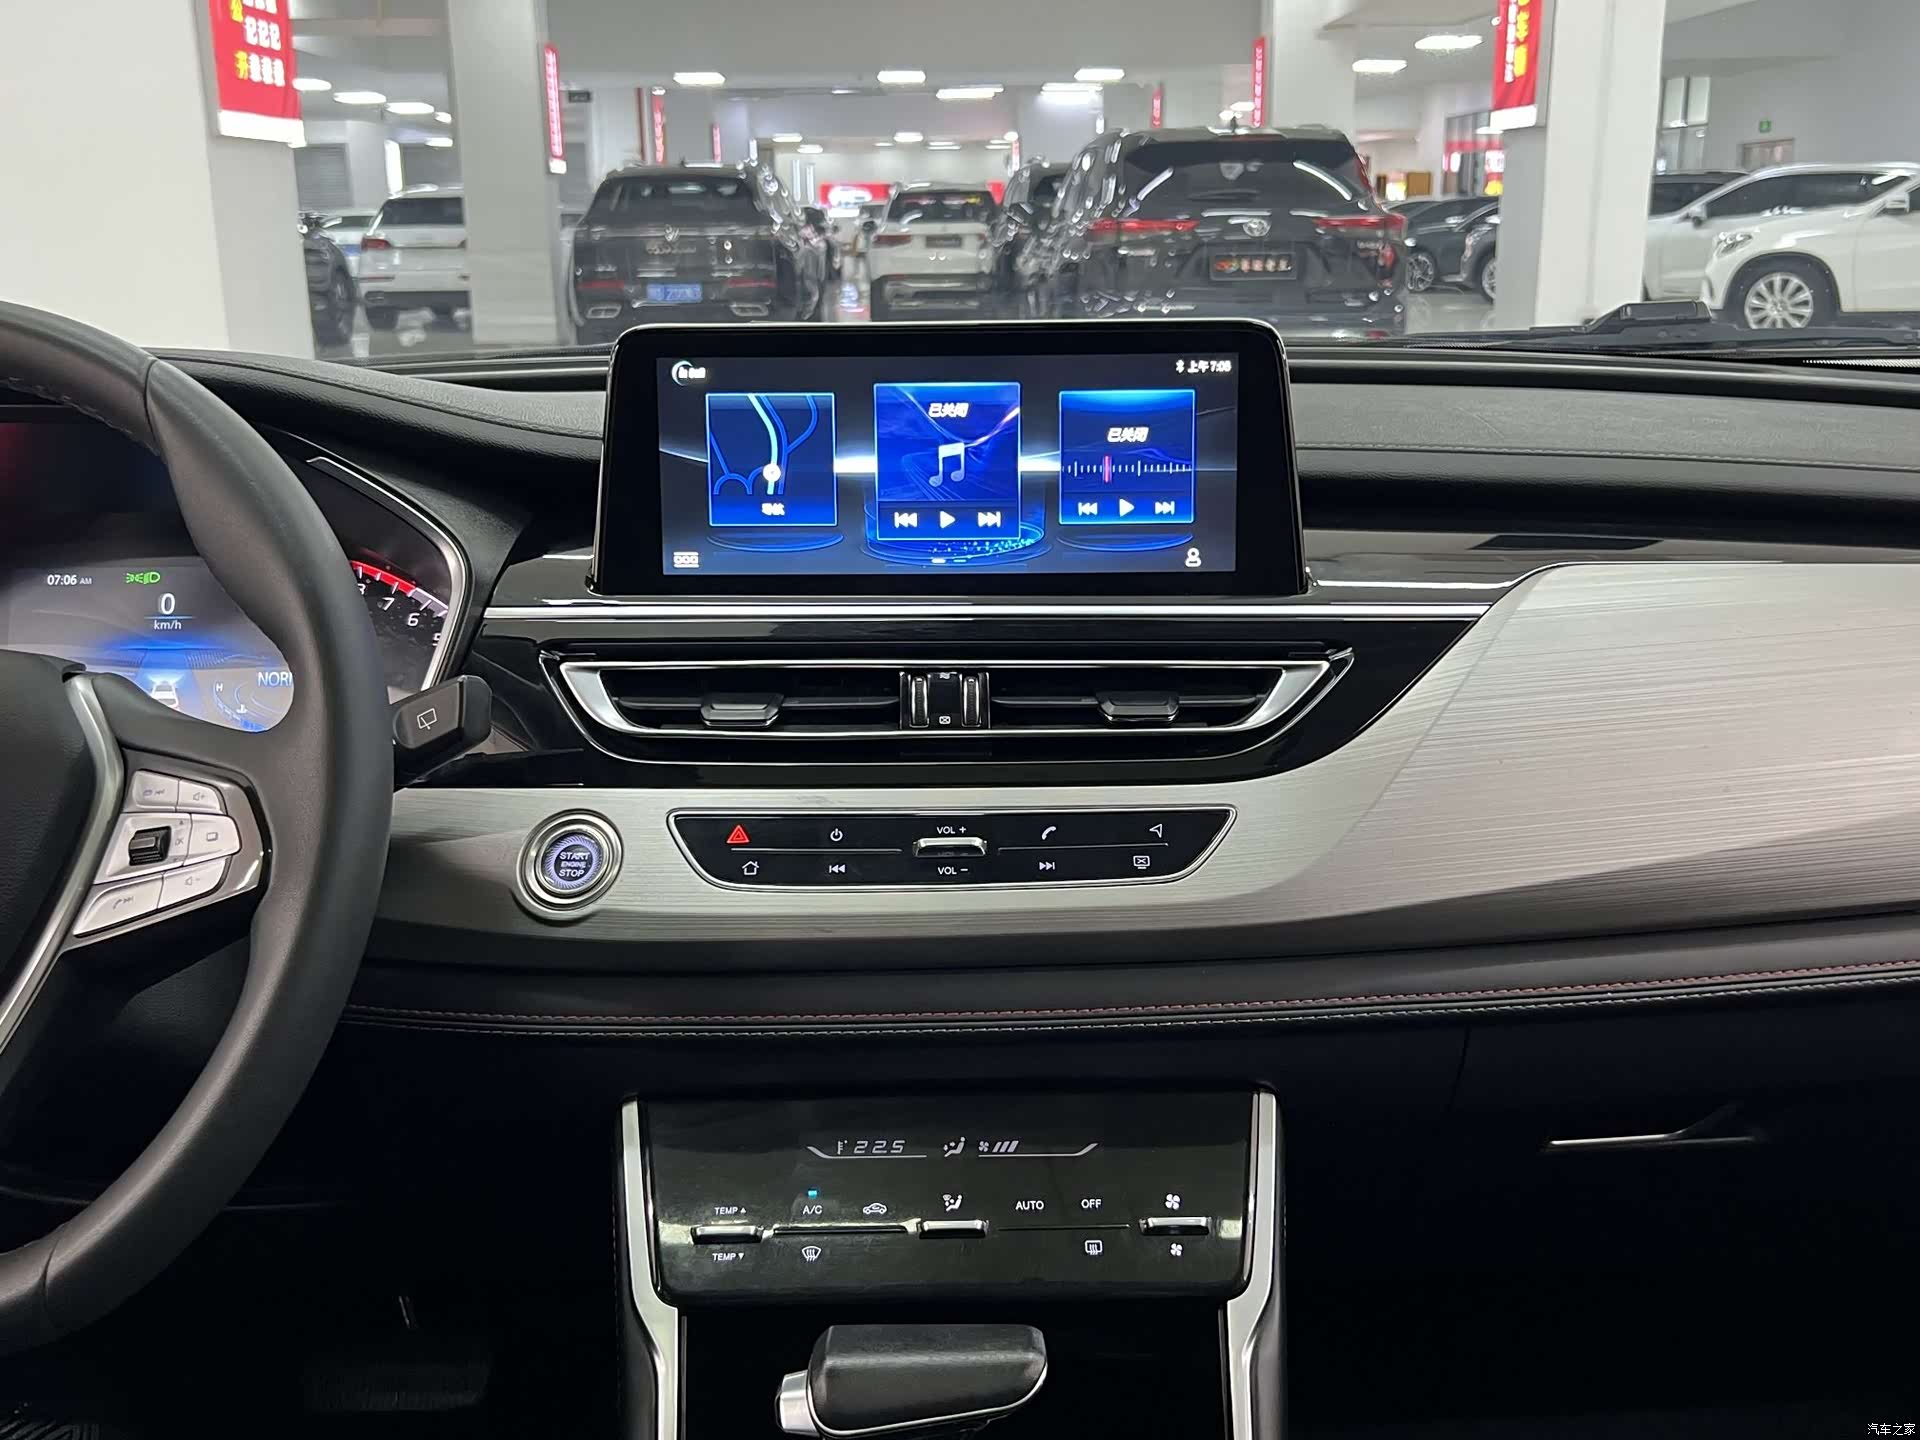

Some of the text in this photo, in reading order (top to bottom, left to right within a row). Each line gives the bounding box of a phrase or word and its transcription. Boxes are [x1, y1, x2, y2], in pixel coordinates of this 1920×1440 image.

[928, 402, 969, 418] 已关闭
[1107, 426, 1149, 443] 已关闭
[47, 574, 92, 586] 07:06 AM
[160, 592, 176, 615] 0
[381, 597, 395, 611] 7
[407, 612, 420, 627] 6
[153, 620, 182, 630] km/h
[936, 825, 956, 835] VOL
[559, 851, 591, 860] START
[558, 869, 585, 877] STOP
[937, 866, 957, 875] VOL
[1015, 1200, 1045, 1210] AUTO
[1080, 1198, 1102, 1209] OFF
[714, 1206, 739, 1215] TEMP
[802, 1204, 823, 1215] A/C
[712, 1252, 737, 1261] TEMP
